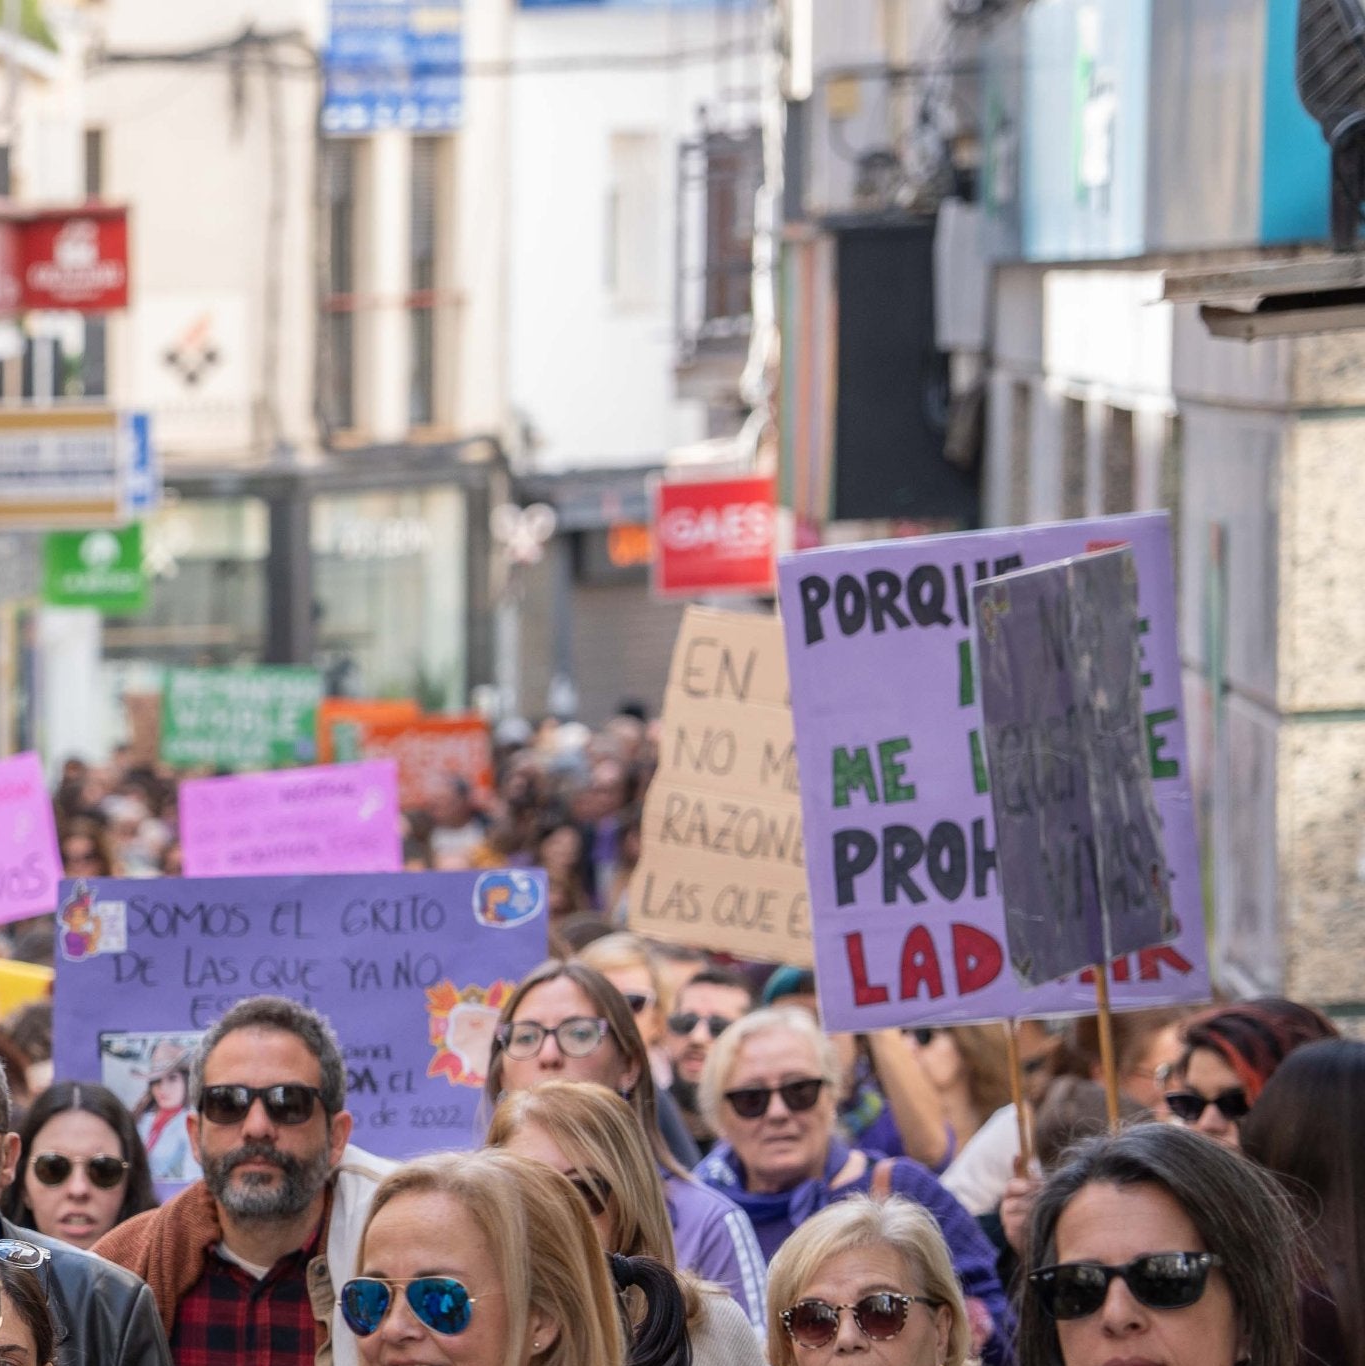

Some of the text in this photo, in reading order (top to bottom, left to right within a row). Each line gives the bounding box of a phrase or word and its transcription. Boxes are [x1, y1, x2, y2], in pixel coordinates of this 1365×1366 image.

[799, 554, 1024, 648] PORQU
[682, 636, 757, 702] EN
[671, 725, 738, 777] NO
[832, 737, 917, 808] ME
[125, 894, 448, 940] SOMOS EL GRITO
[640, 870, 703, 924] LAS
[711, 883, 779, 934] QUE
[113, 946, 442, 993] DE LAS QUE YA NO
[411, 1102, 466, 1129] 2022
